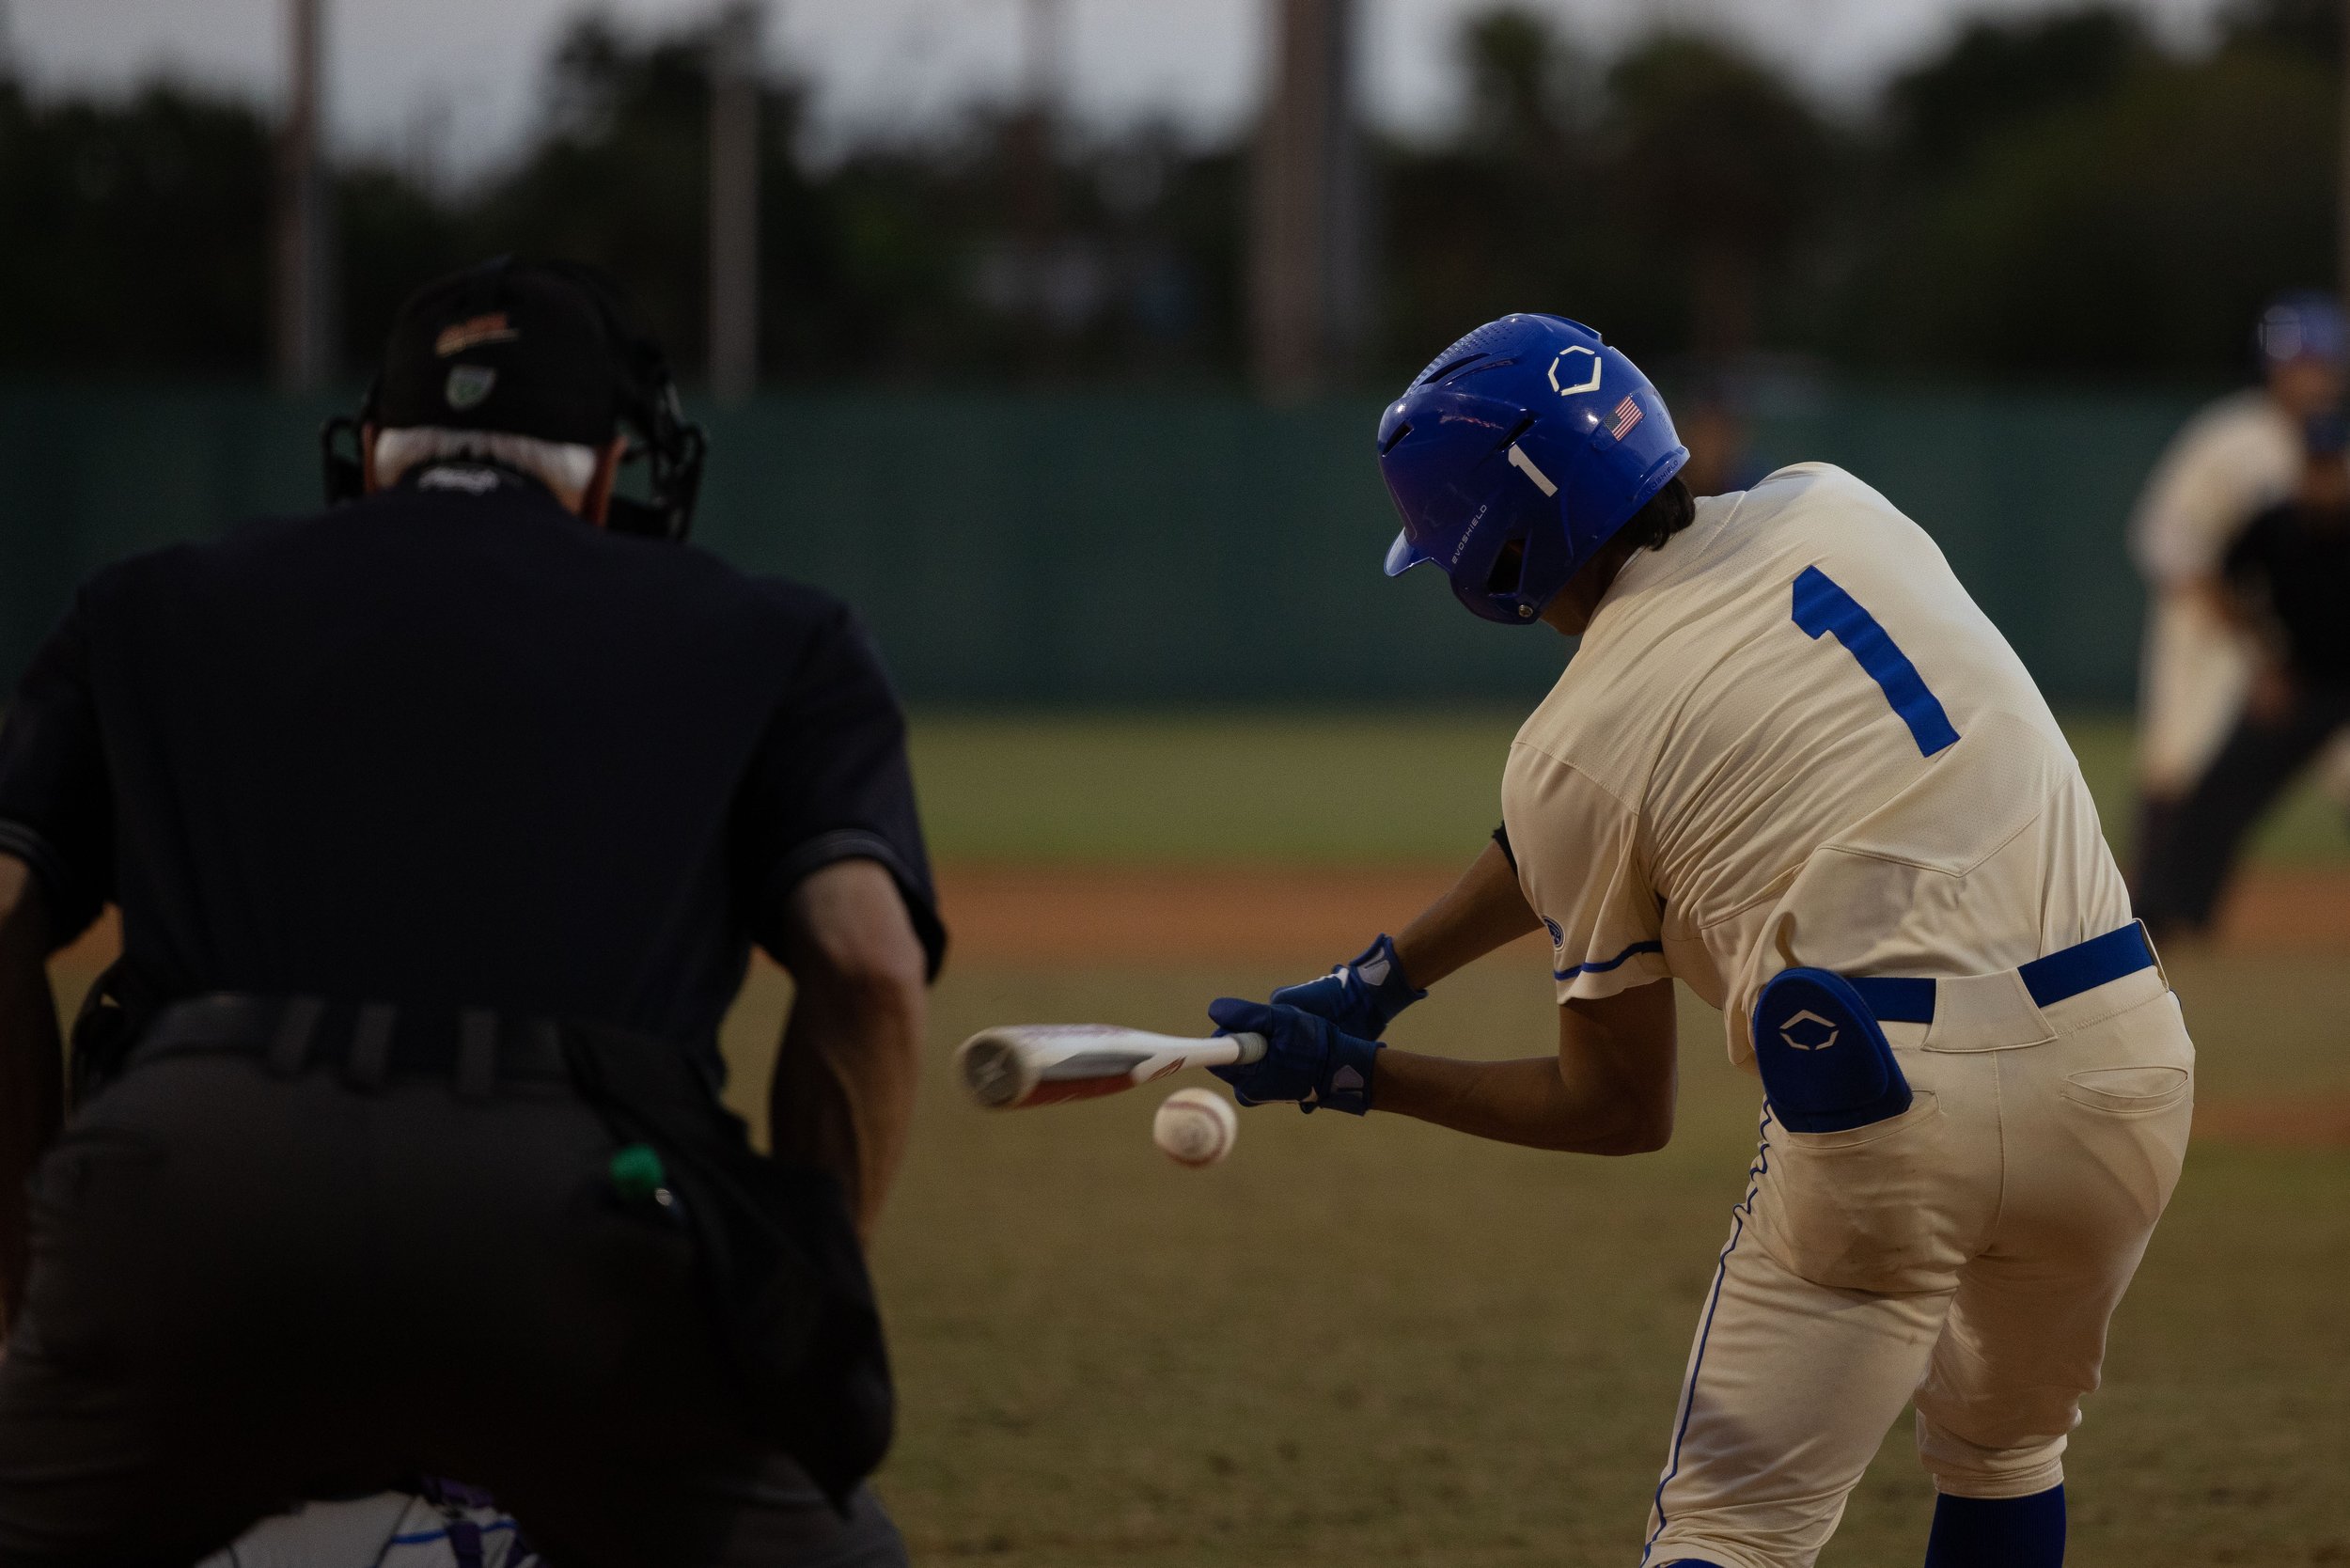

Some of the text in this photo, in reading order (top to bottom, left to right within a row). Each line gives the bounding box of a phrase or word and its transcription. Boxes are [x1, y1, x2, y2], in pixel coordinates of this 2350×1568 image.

[1508, 444, 1559, 497] 1
[1451, 504, 1488, 564] EVOSHIELD
[1792, 566, 1960, 757] 1
